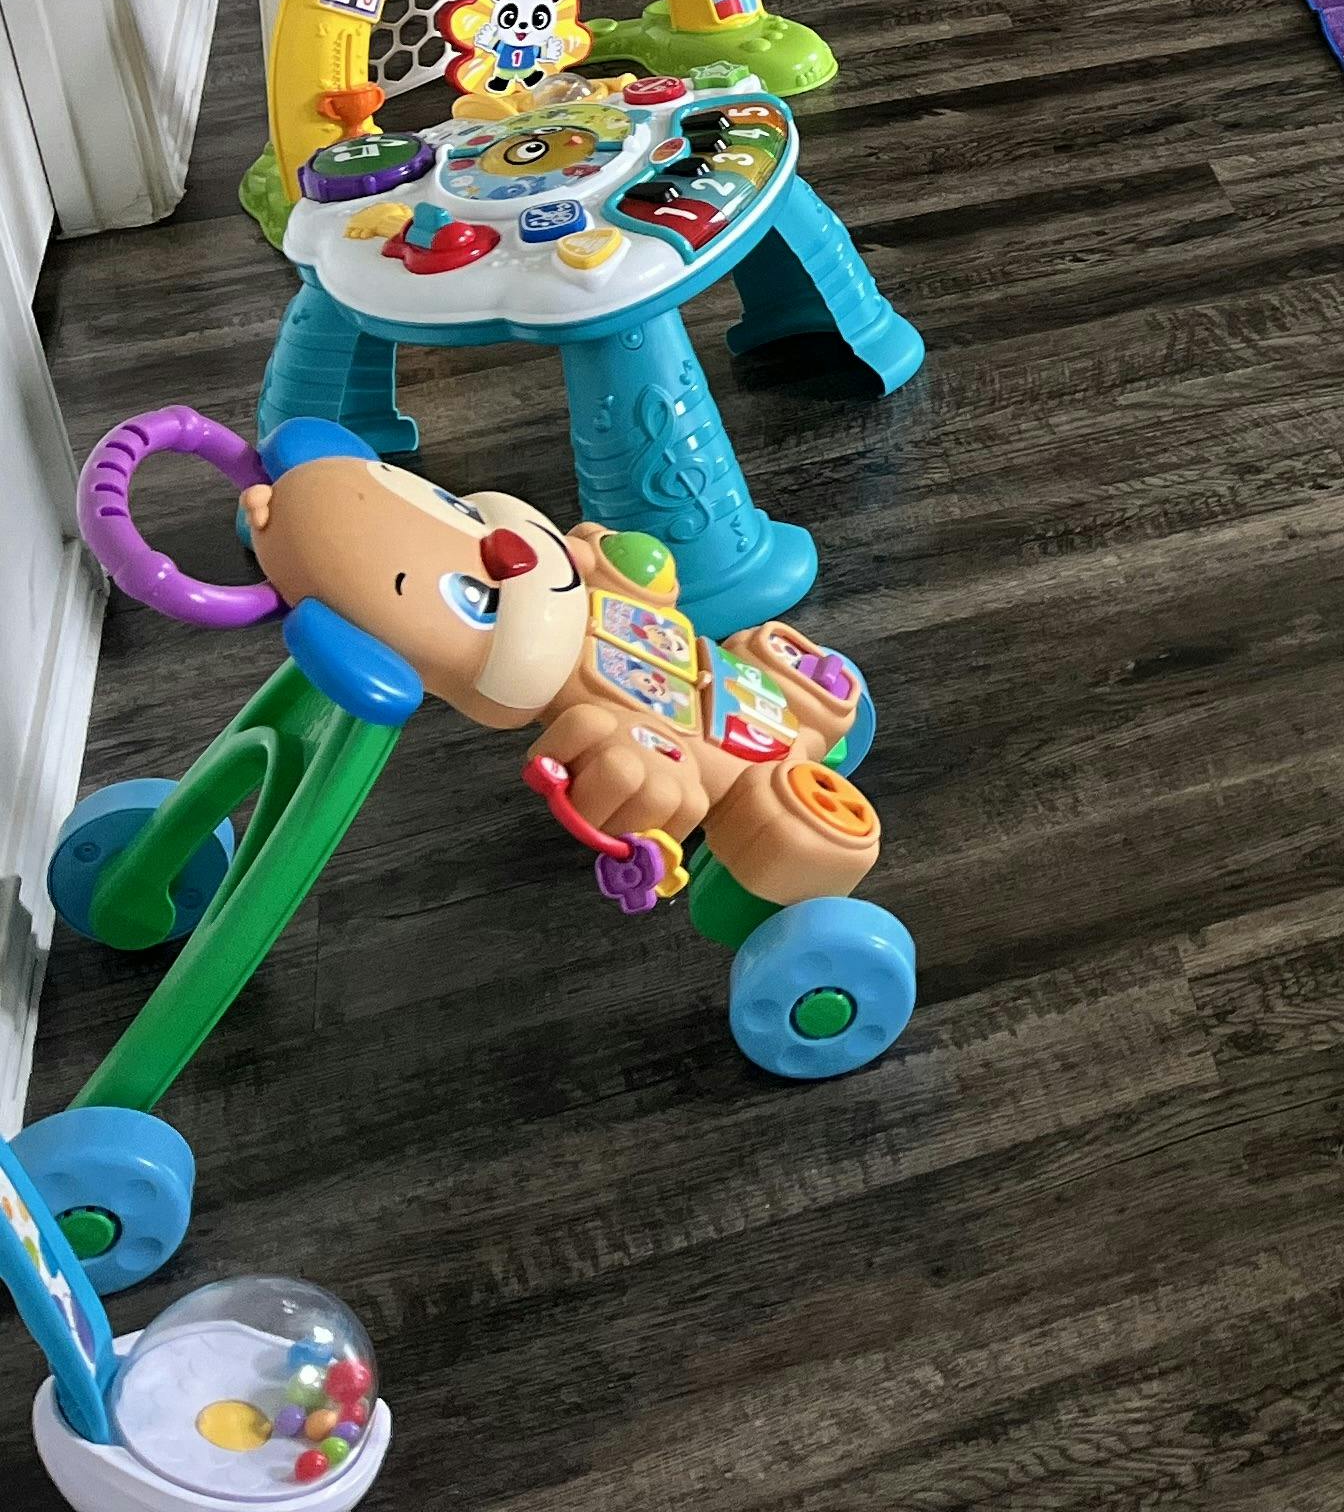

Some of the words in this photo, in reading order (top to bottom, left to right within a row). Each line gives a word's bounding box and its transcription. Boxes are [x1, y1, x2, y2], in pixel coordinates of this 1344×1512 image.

[511, 50, 522, 67] 1
[728, 106, 770, 118] 5
[728, 128, 770, 139] 4
[712, 153, 755, 166] 3
[690, 178, 736, 197] 2
[653, 206, 698, 221] 1
